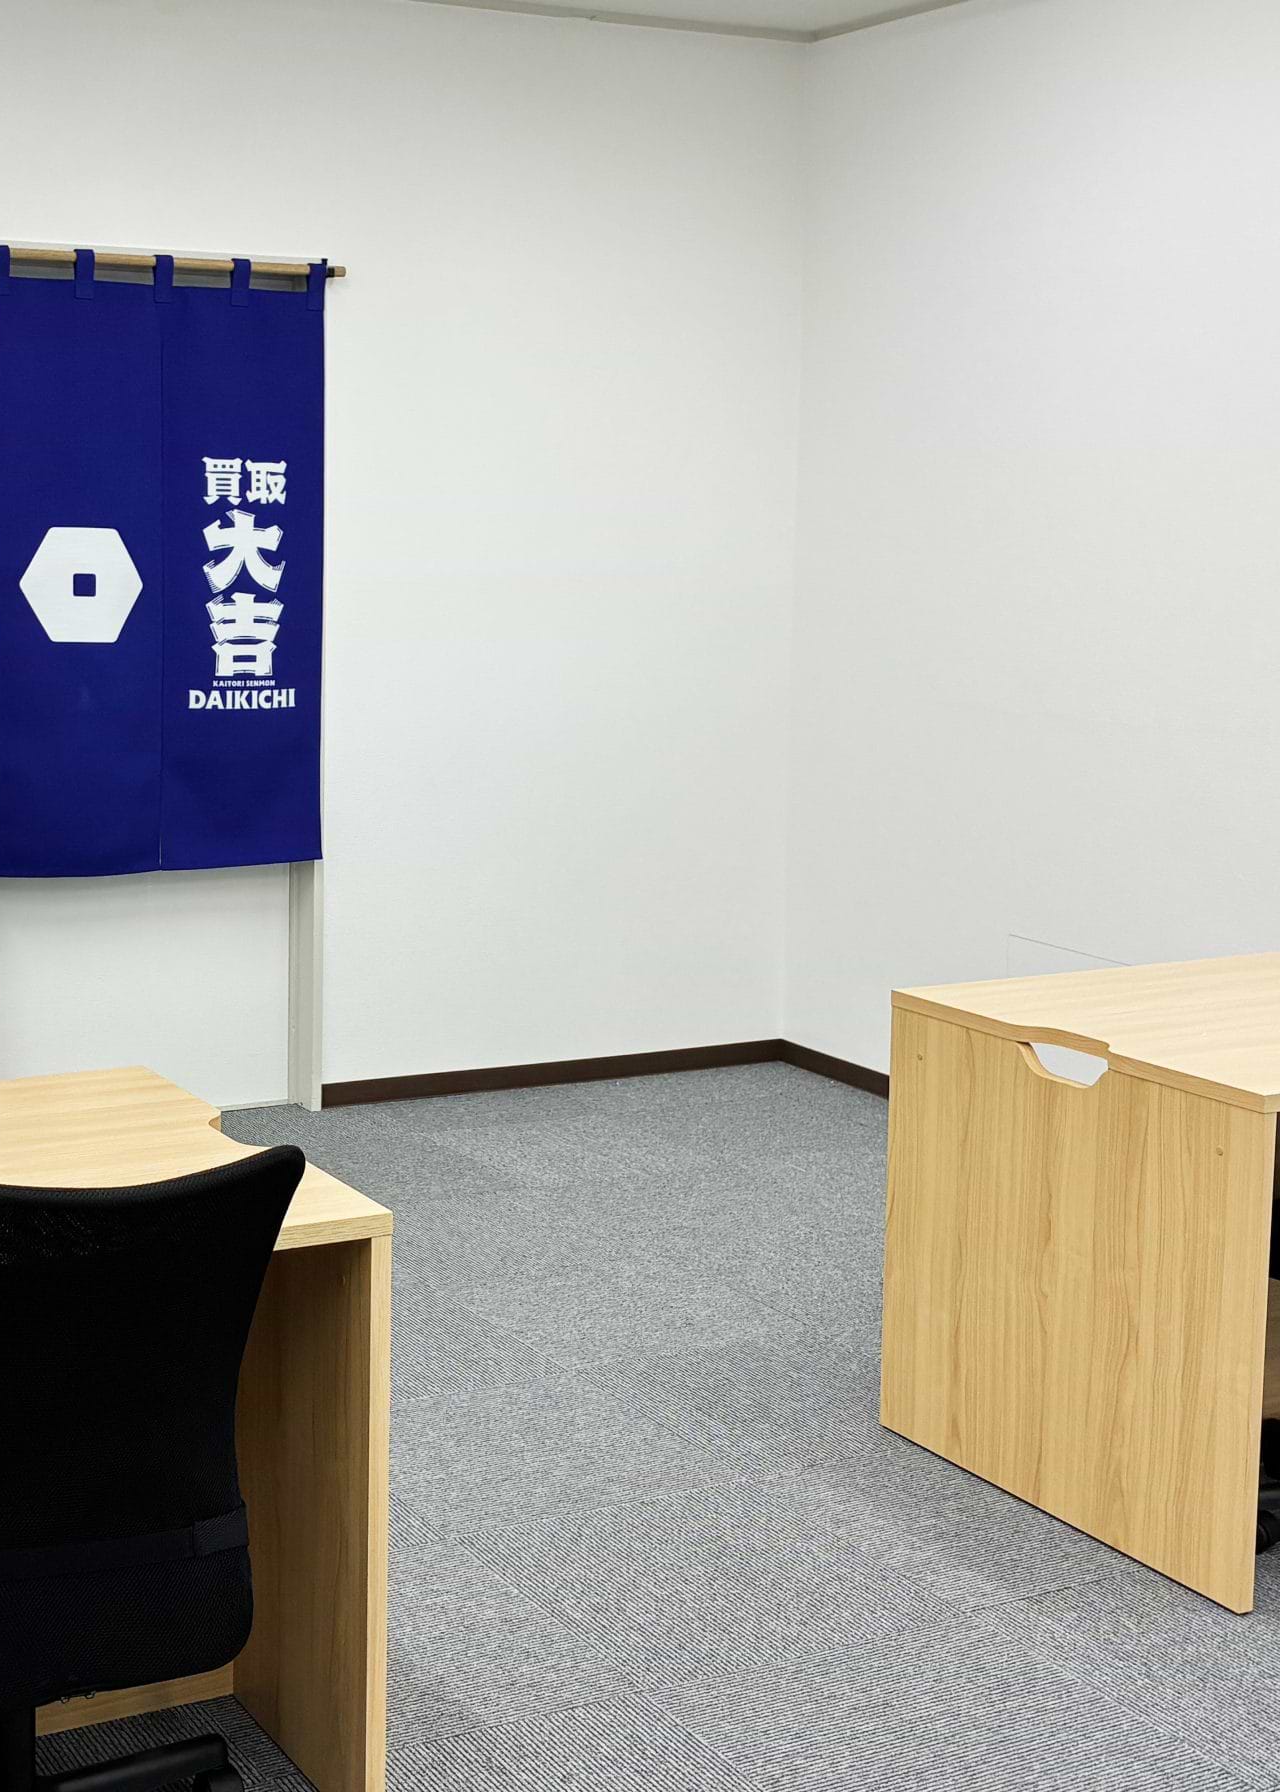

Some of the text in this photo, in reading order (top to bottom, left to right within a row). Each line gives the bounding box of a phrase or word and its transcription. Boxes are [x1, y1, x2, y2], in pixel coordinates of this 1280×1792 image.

[201, 456, 287, 505] 買取
[202, 508, 286, 677] 大吉
[188, 688, 296, 710] DAIKICHI
[246, 679, 276, 687] SENMON
